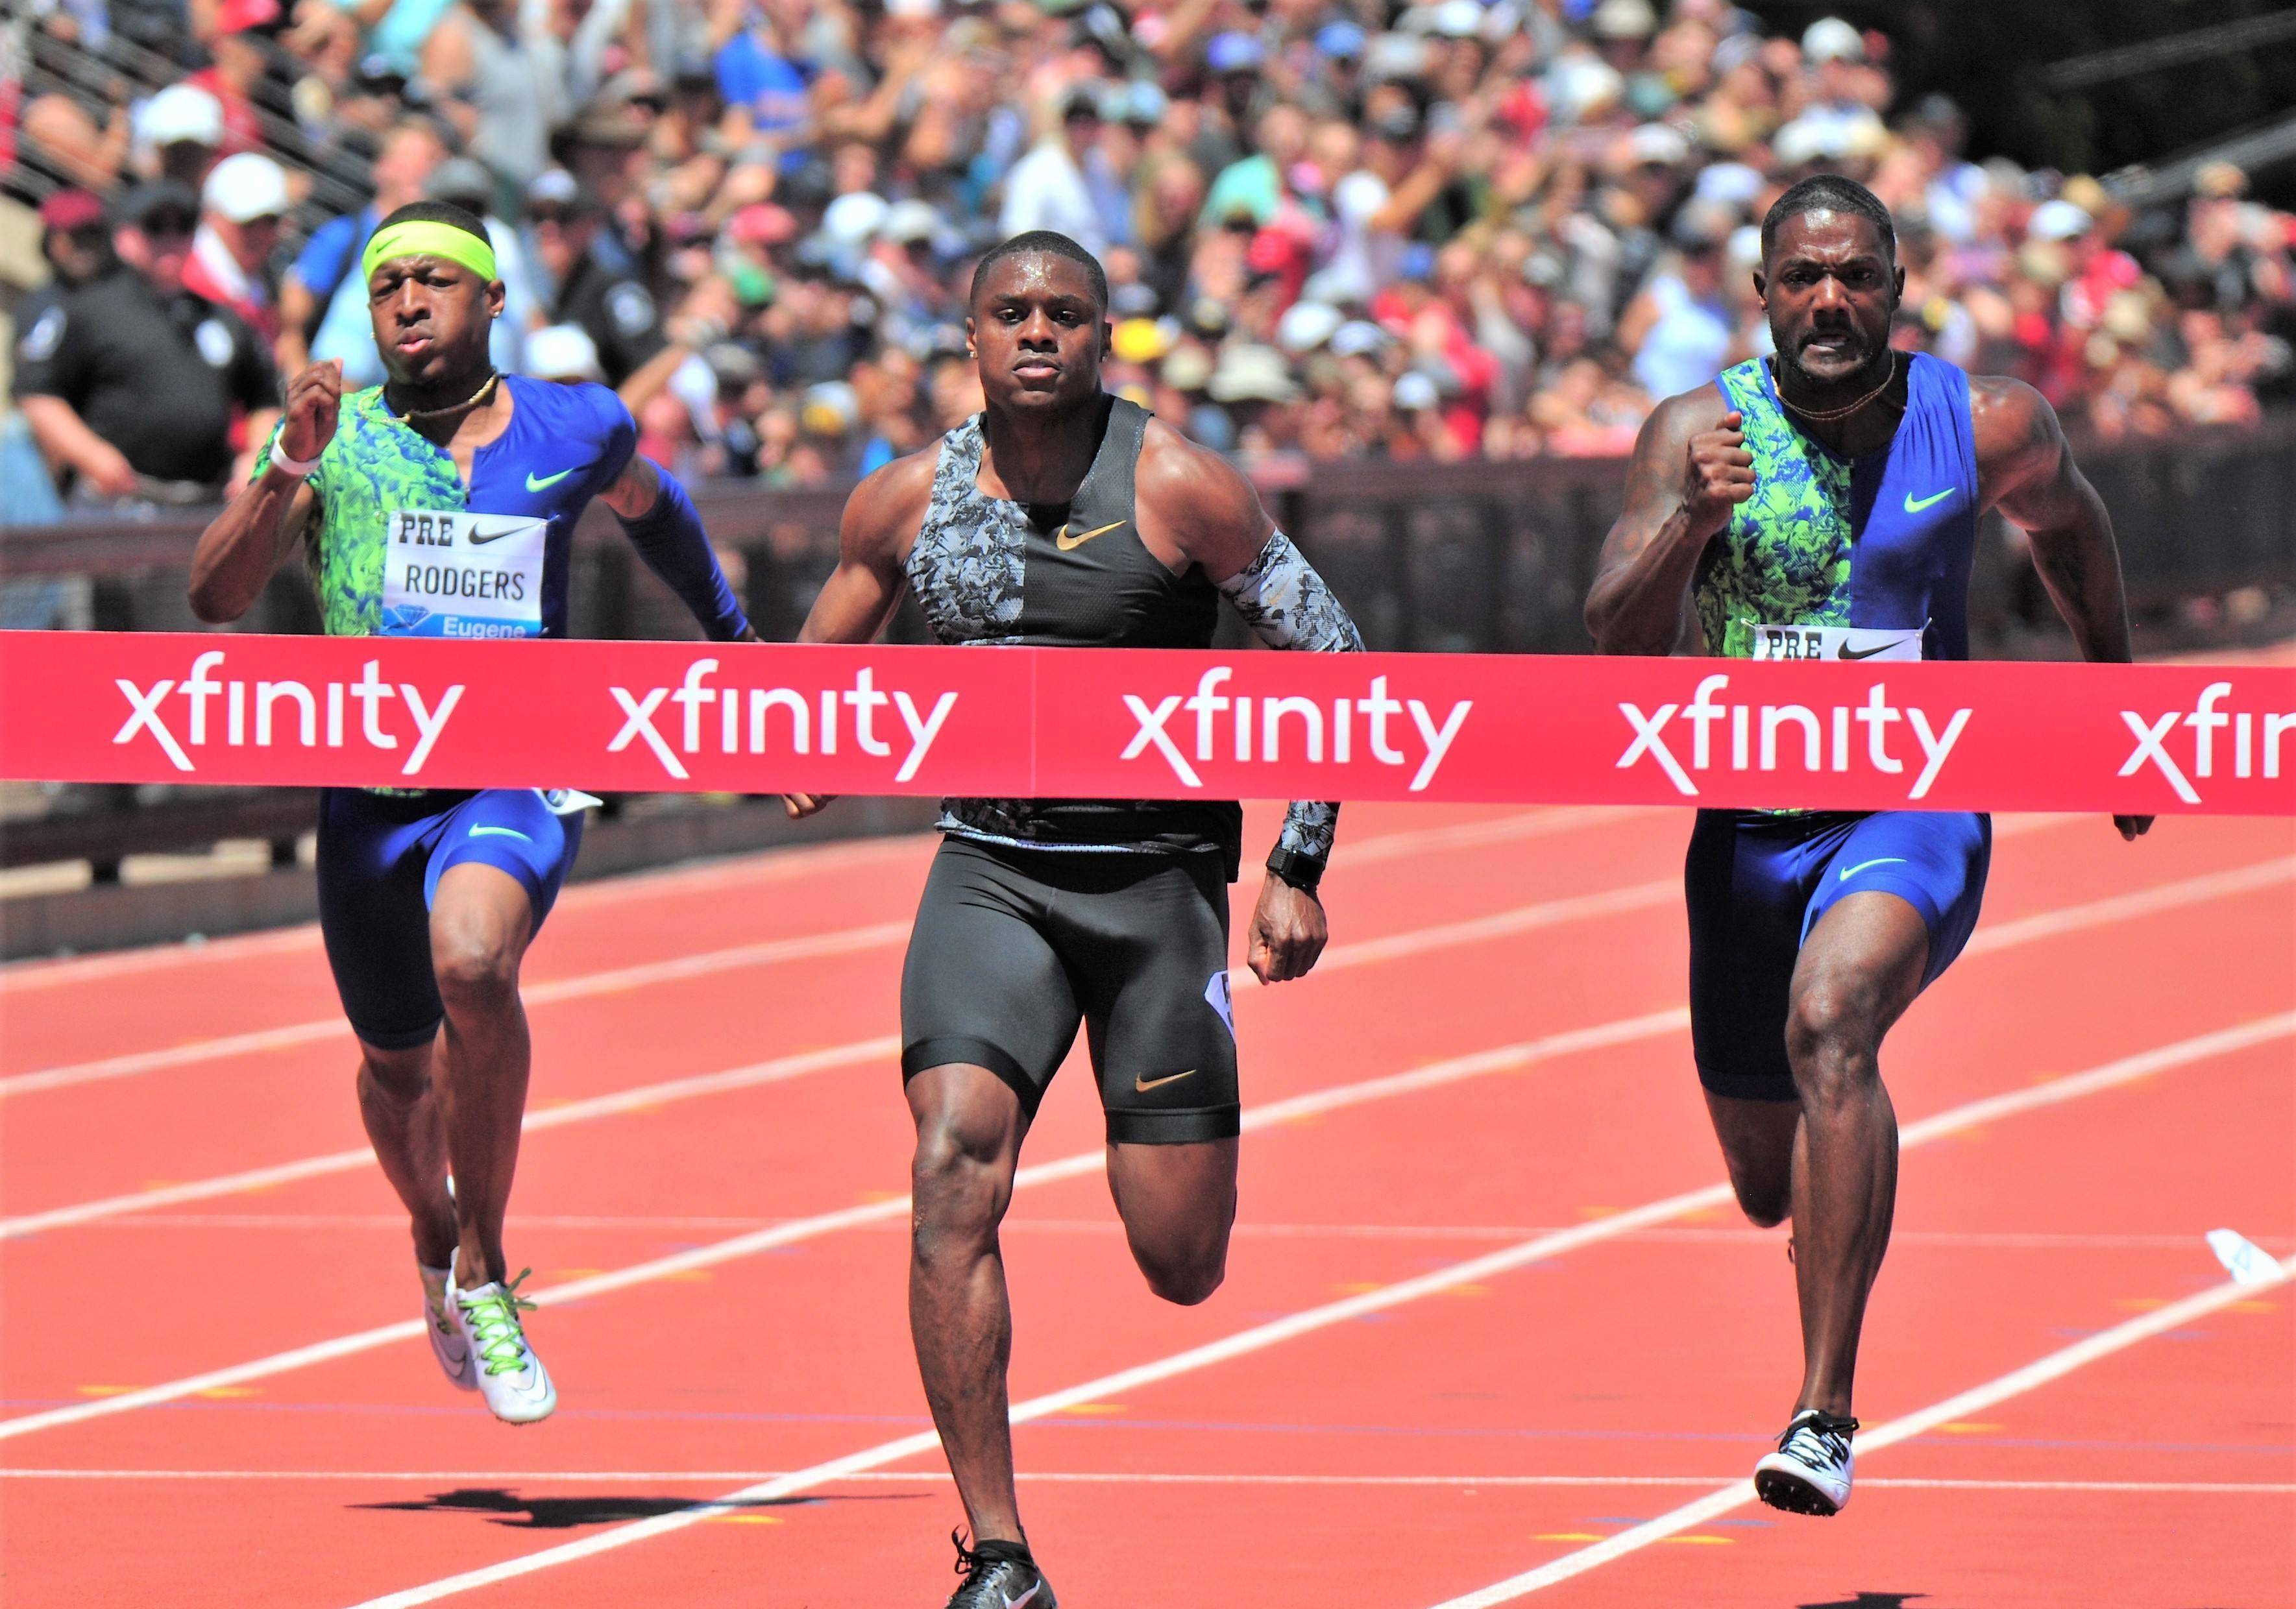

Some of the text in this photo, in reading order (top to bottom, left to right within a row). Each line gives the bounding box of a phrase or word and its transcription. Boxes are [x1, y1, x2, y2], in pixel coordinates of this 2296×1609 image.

[399, 513, 453, 546] PRE
[405, 564, 526, 601] RODGERS
[443, 617, 526, 638] Eugene
[1765, 630, 1822, 659] PRE
[112, 650, 466, 776] xfinity
[607, 657, 959, 783] xfinity
[1120, 666, 1474, 792] xfinity
[1615, 673, 1973, 800] xfinity
